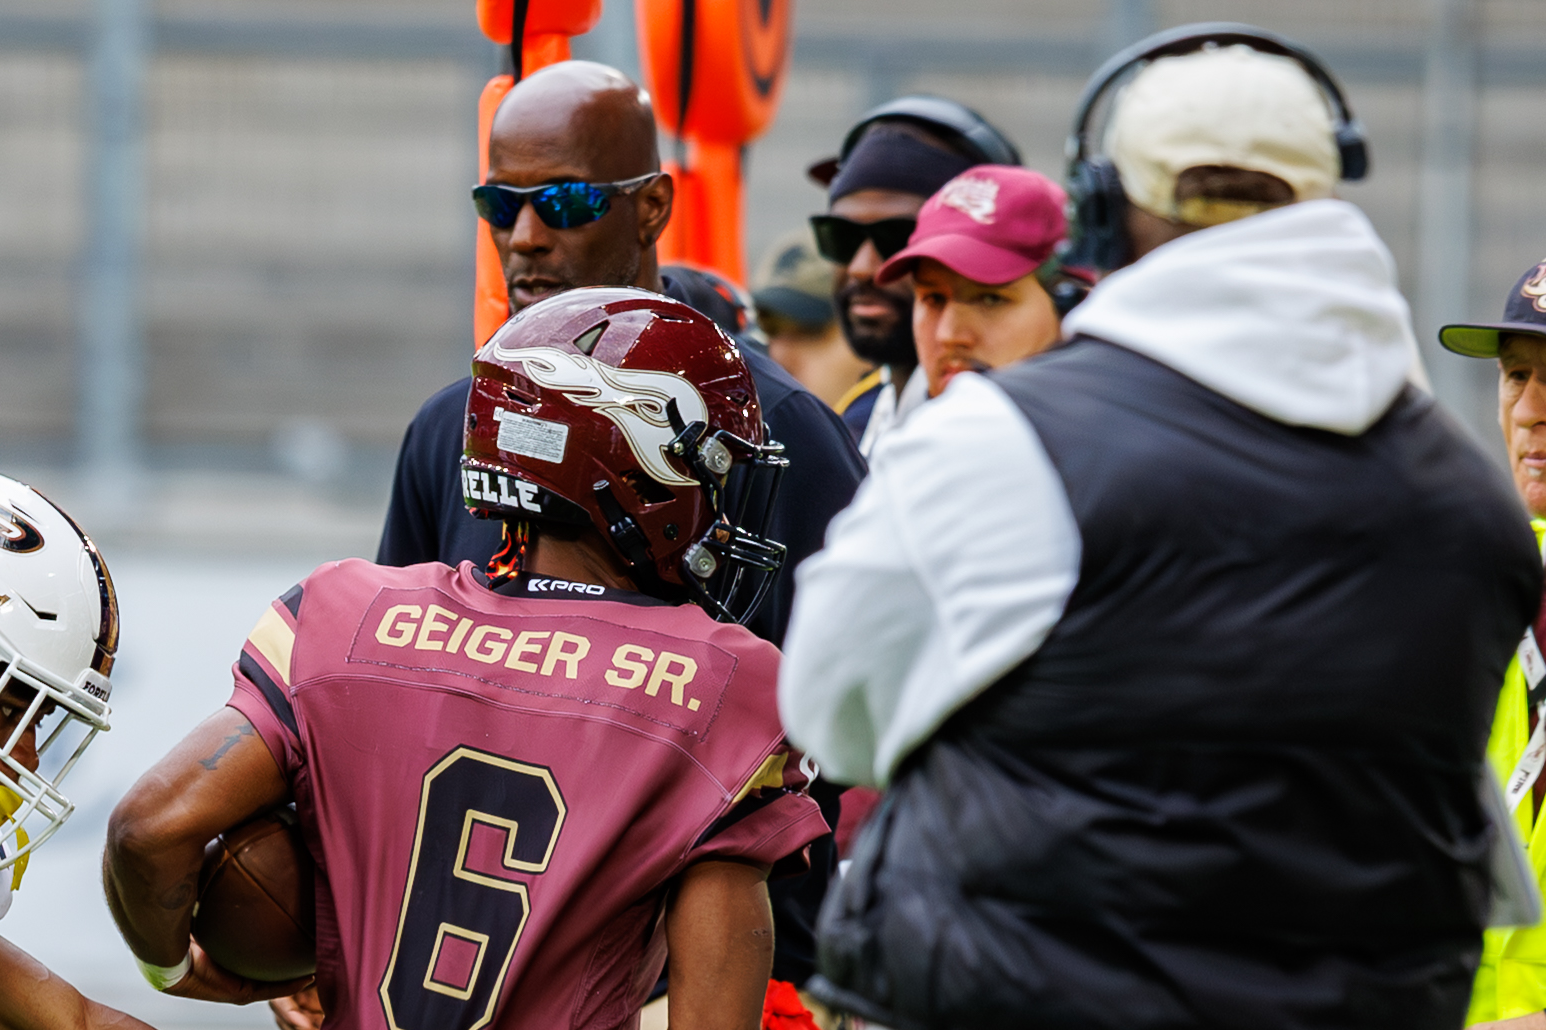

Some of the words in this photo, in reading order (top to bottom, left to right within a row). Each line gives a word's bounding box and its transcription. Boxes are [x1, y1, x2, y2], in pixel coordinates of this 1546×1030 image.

[527, 578, 605, 596] KPRO
[374, 603, 591, 680] GEIGER
[604, 643, 702, 712] SR.
